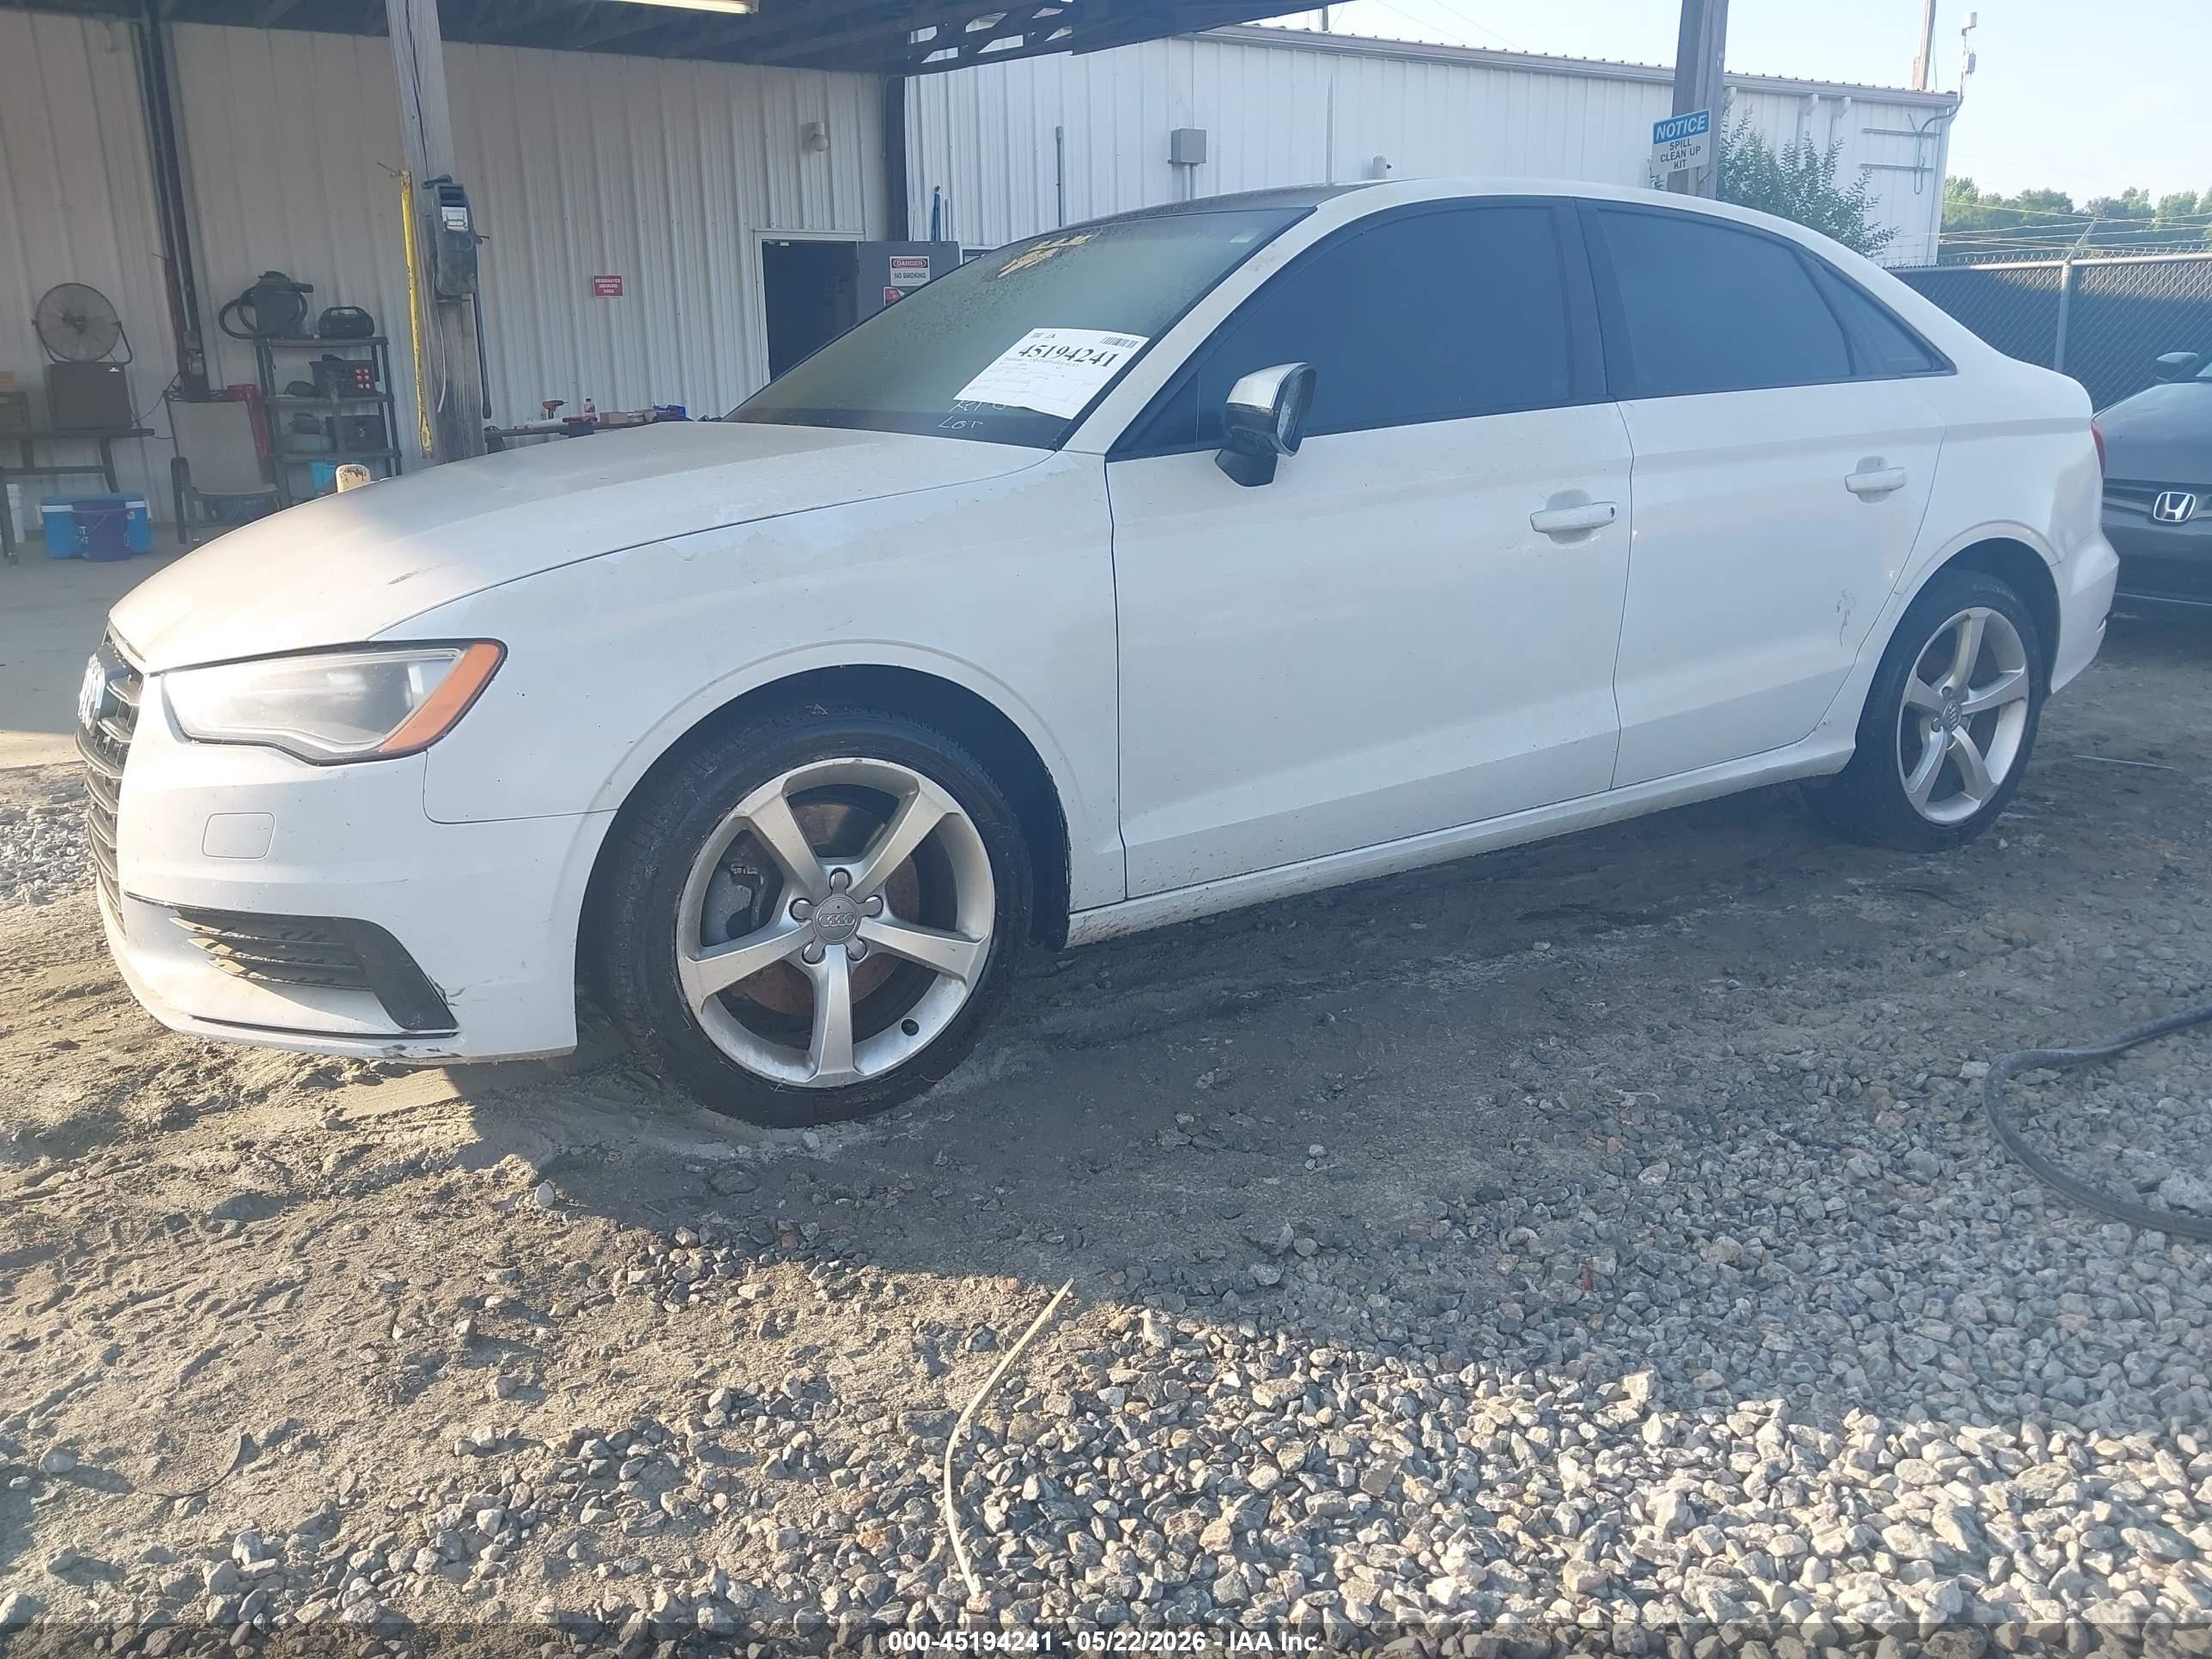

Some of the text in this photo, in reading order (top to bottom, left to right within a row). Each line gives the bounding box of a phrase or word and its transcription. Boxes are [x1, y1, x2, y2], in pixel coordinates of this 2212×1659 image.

[1656, 114, 1707, 141] NOTICE
[1669, 137, 1692, 151] SPILL
[1660, 145, 1701, 162] CLEAN UP
[1674, 159, 1687, 170] KIT
[1018, 343, 1120, 368] 45194241
